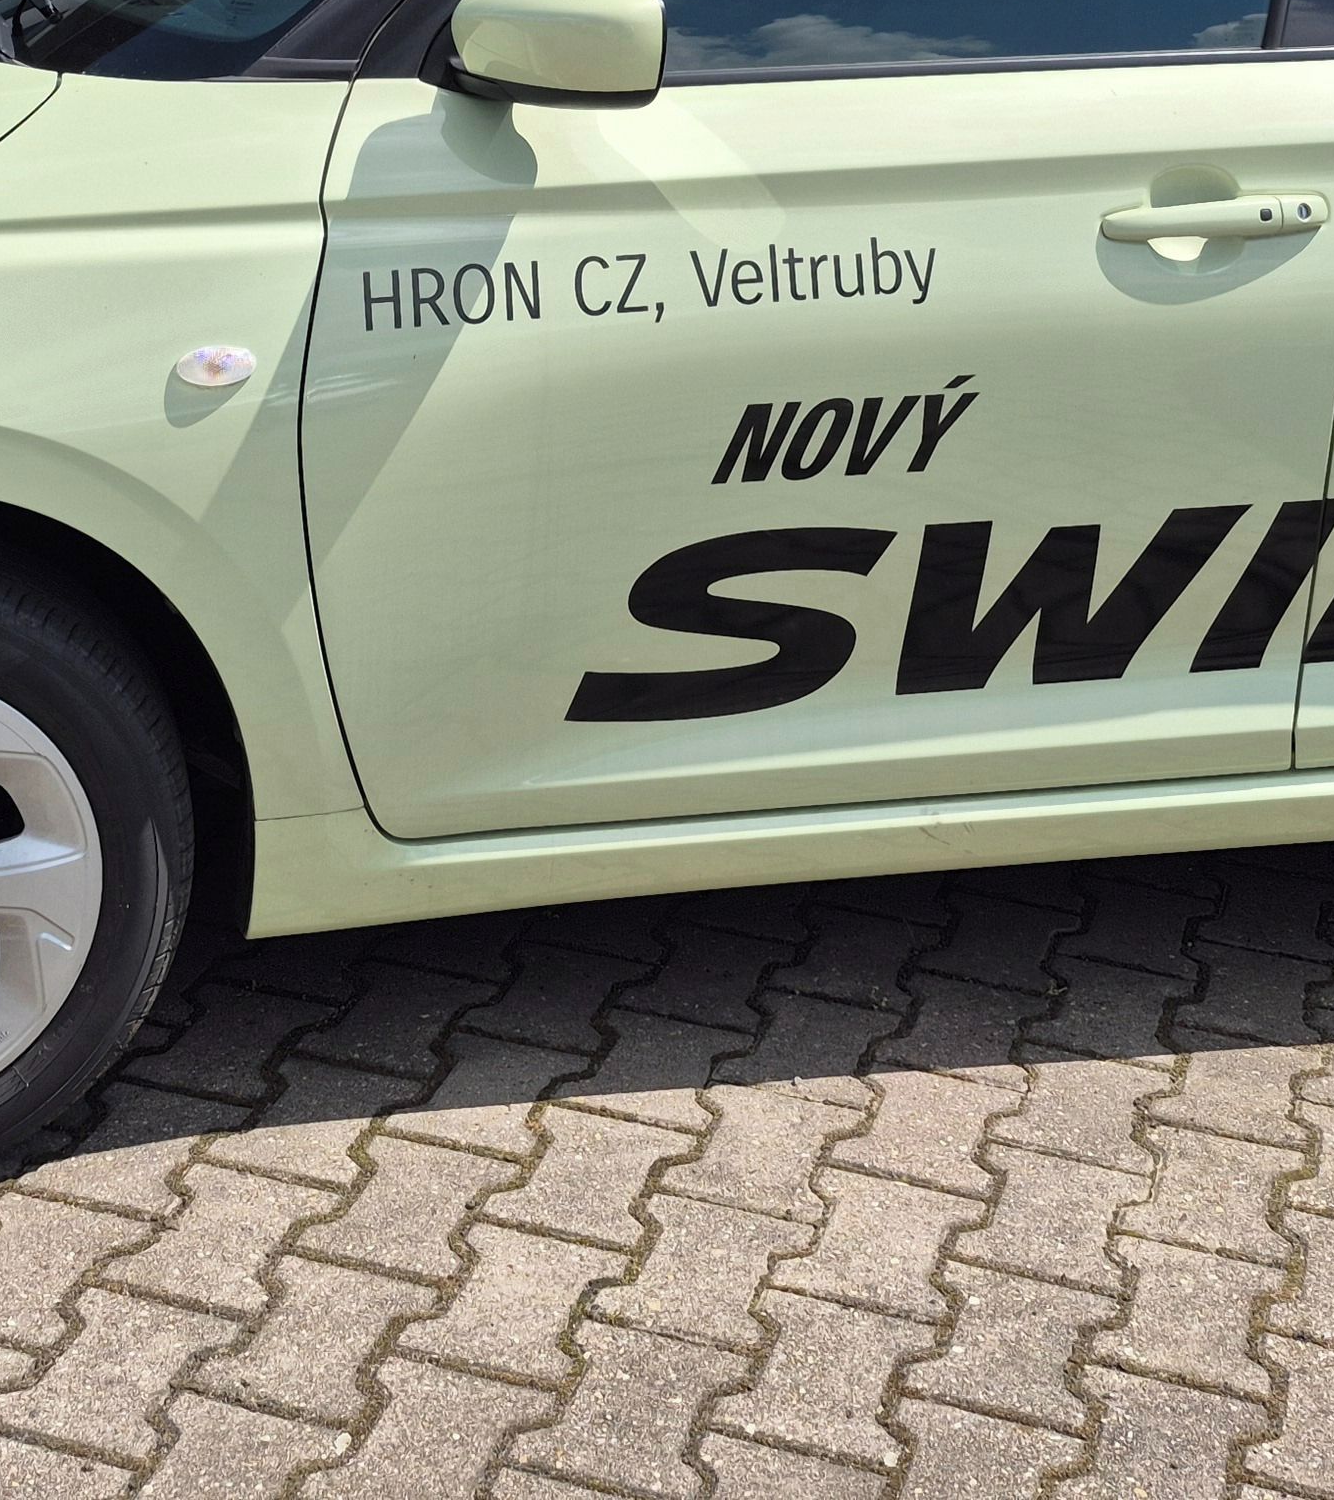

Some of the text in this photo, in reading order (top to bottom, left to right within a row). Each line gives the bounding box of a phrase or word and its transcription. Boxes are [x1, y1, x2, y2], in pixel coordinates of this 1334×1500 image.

[362, 237, 936, 332] HRON CZ, Veltruby
[710, 374, 980, 485] NOVÝ
